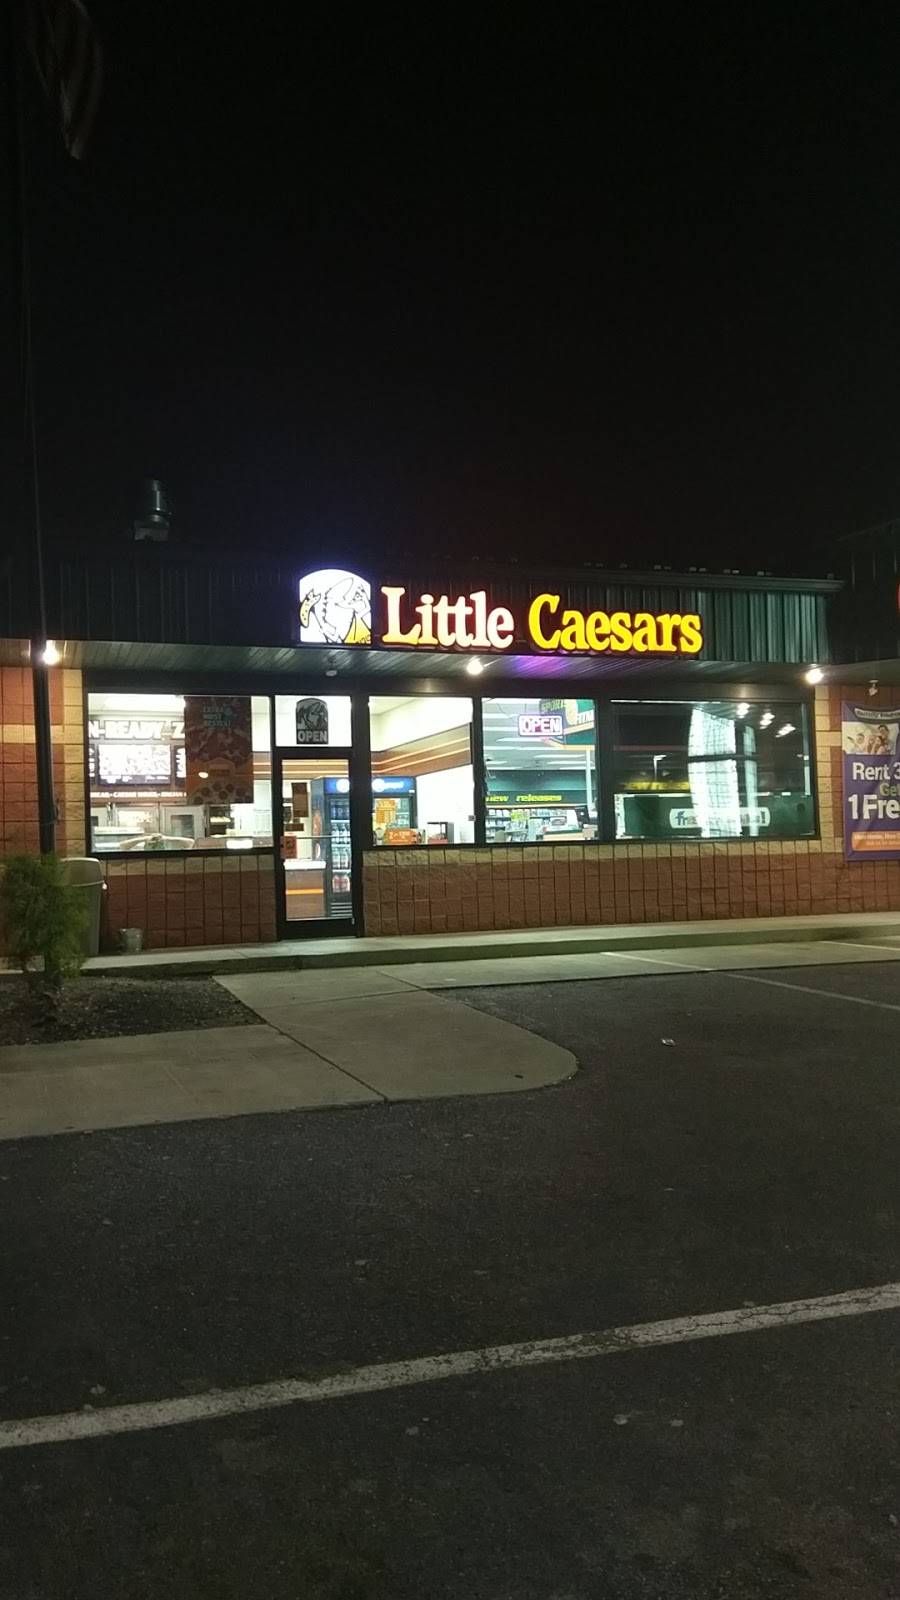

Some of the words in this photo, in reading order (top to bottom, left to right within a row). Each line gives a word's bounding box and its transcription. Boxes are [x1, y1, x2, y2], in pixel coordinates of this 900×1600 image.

[380, 586, 514, 649] Little
[528, 593, 703, 654] Caesars
[521, 717, 560, 734] OPEN
[297, 730, 327, 743] OPEN
[852, 762, 890, 780] Rent
